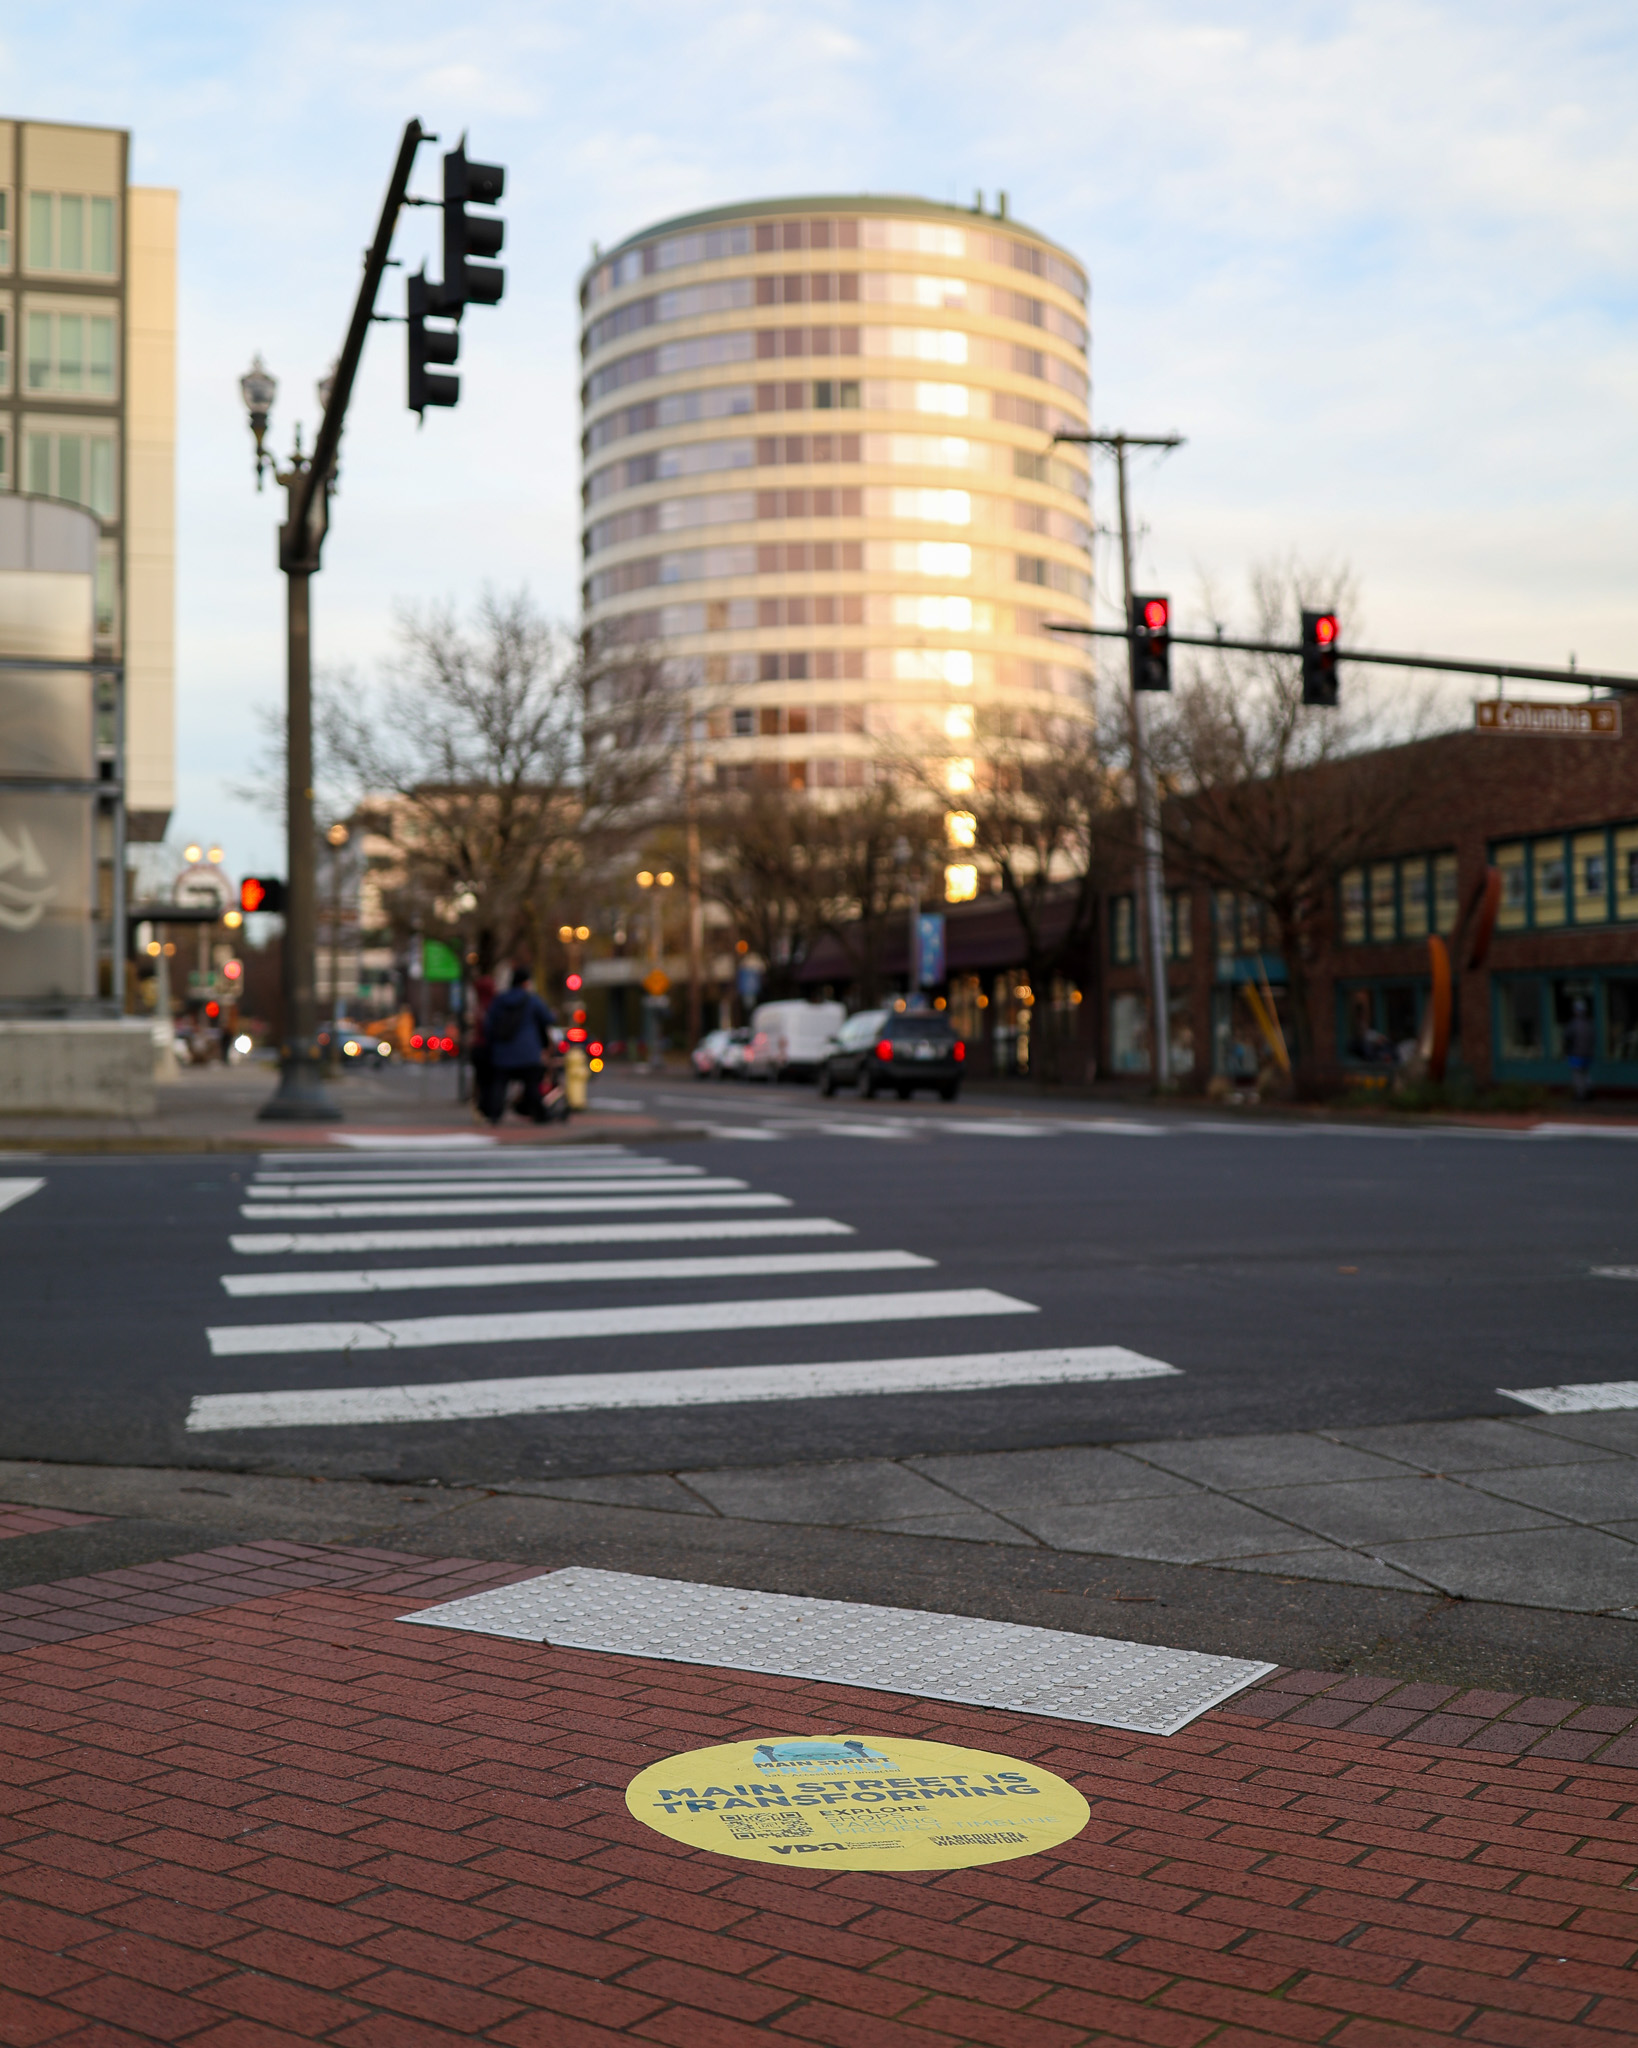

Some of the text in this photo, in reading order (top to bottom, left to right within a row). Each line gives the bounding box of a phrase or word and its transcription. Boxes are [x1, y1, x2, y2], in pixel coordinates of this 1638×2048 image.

[1498, 702, 1592, 733] Columbia
[755, 1757, 890, 1768] MAIN STREET
[759, 1762, 900, 1774] PROMISE
[657, 1772, 1029, 1801] MAIN STREET IS
[653, 1784, 1041, 1813] TRANSFORMING
[819, 1806, 930, 1816] EXPLORE
[825, 1813, 904, 1822] SHOPS
[830, 1817, 938, 1828] PARKING
[836, 1815, 1061, 1835] PROJECT TIMELINE
[935, 1831, 1017, 1841] VANCOUVER
[933, 1838, 1023, 1847] WASHINGTON
